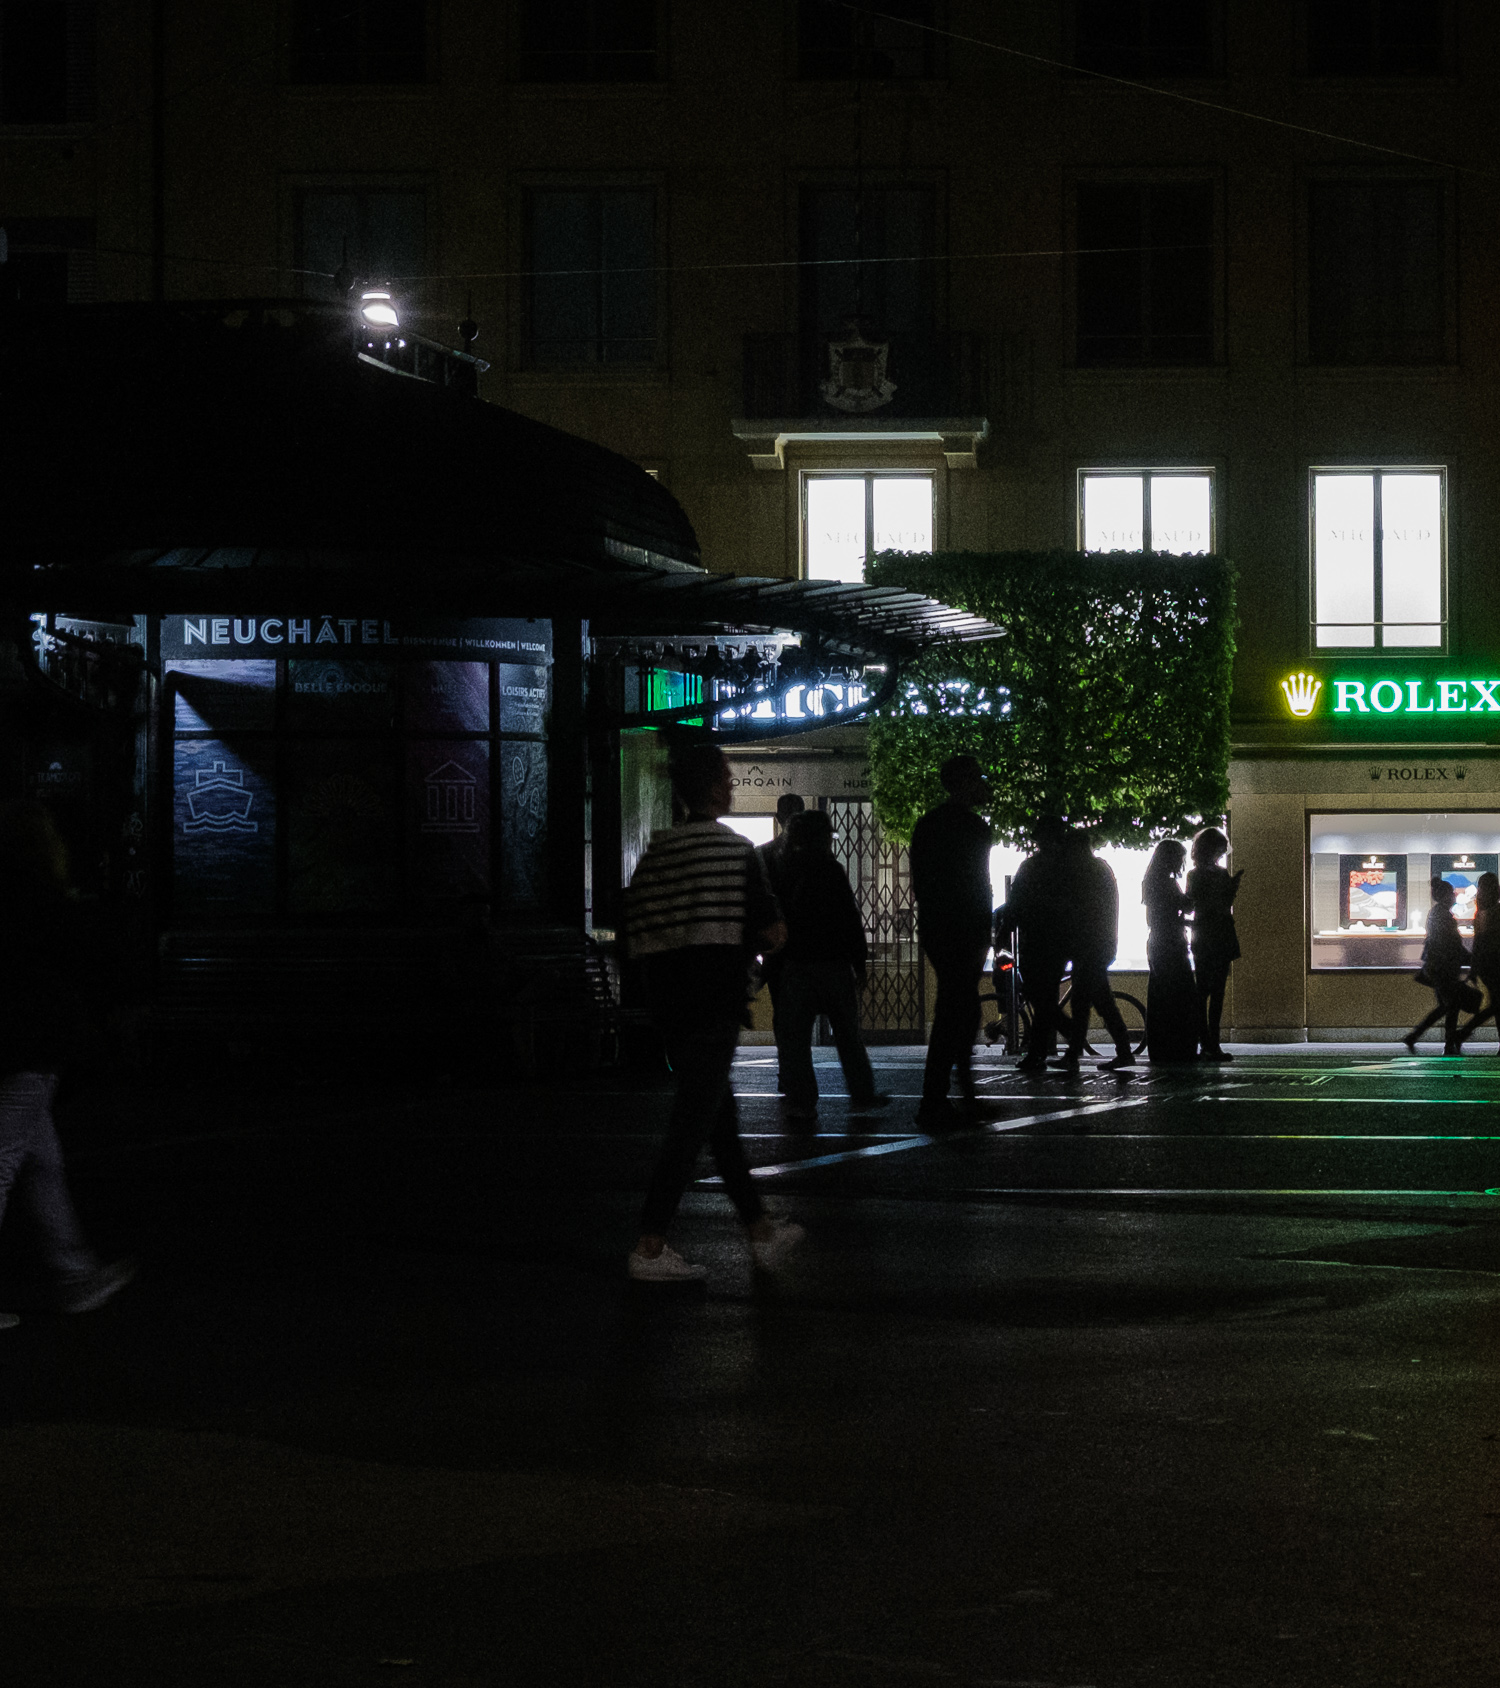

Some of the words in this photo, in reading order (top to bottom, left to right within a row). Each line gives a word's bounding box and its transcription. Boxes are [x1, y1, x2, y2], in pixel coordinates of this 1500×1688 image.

[1327, 528, 1432, 543] MICAUD
[184, 615, 399, 645] NEUCHÂTEL
[464, 639, 516, 650] WILLKOMMEN
[521, 643, 546, 652] WELCOME
[294, 682, 334, 693] BELLE
[502, 685, 528, 697] LOISIRS
[1387, 768, 1448, 781] ROLEX
[730, 777, 792, 787] ORQAIN
